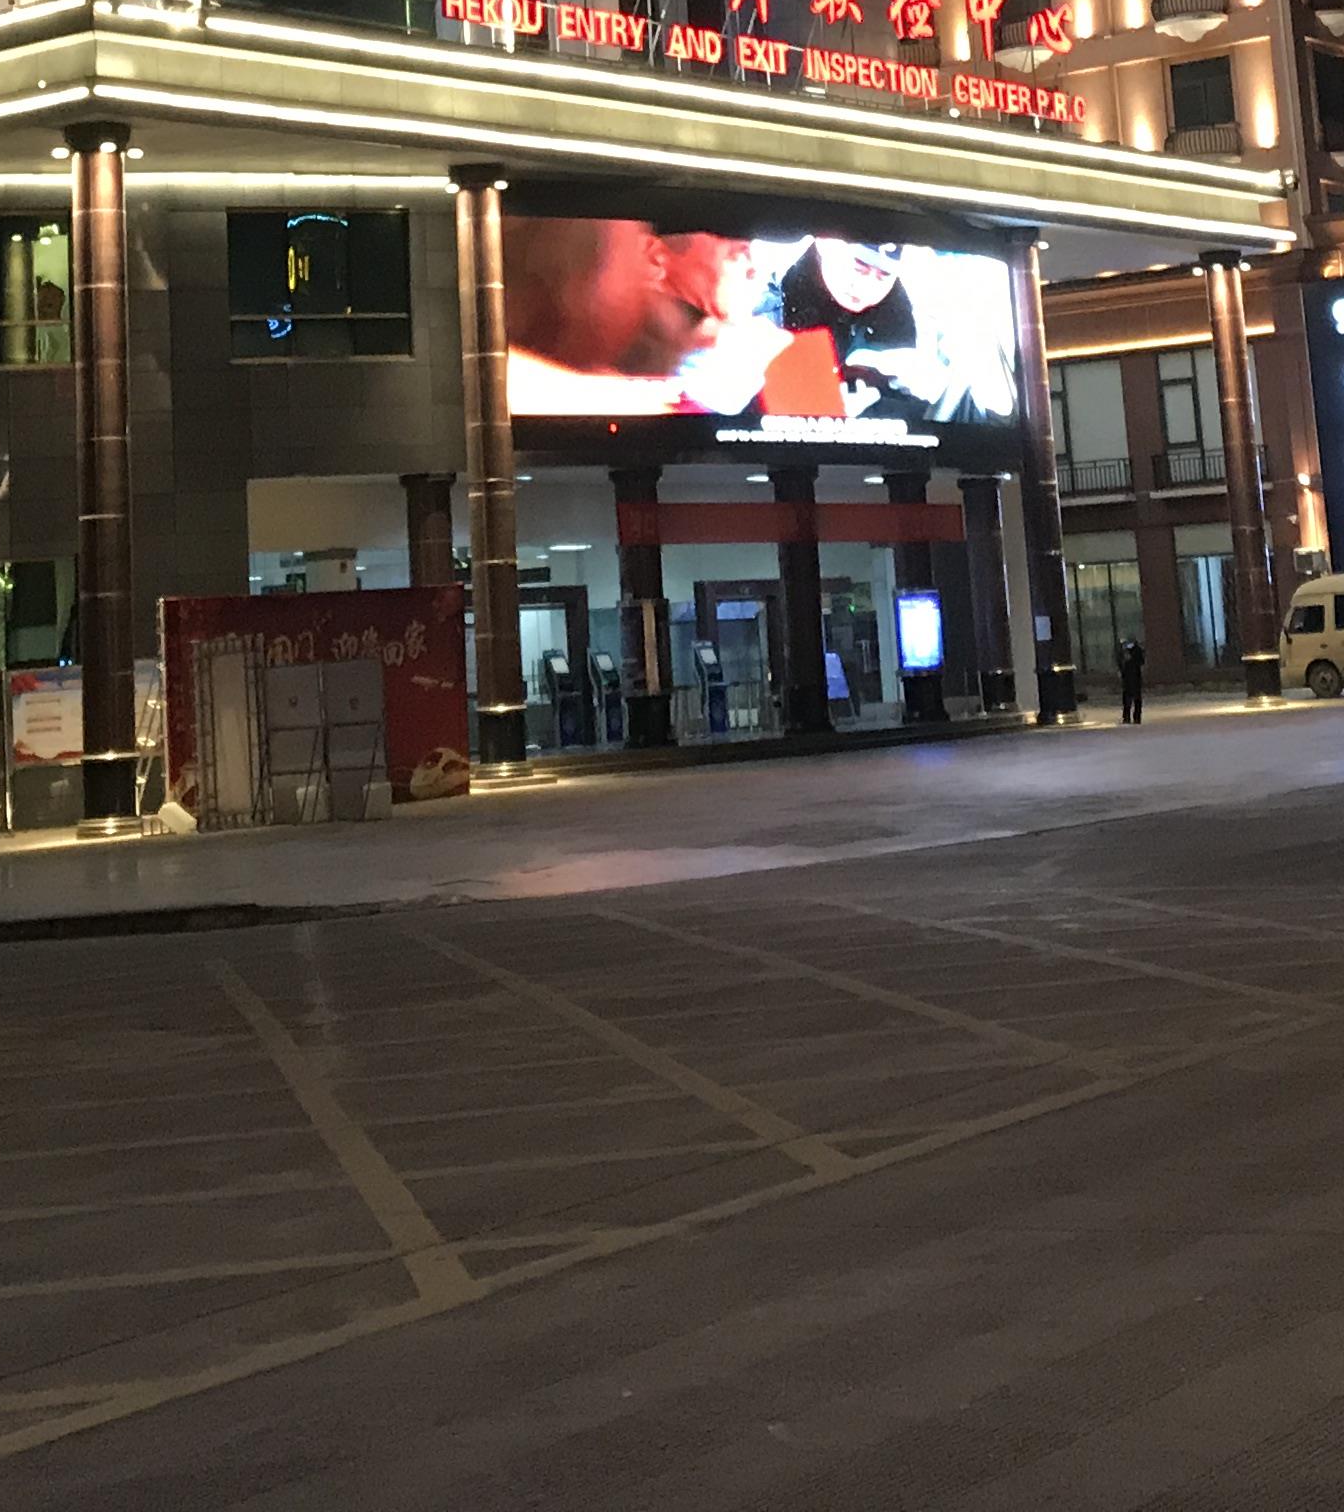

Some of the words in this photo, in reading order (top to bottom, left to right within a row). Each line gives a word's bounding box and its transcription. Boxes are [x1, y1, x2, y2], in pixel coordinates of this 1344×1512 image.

[556, 3, 646, 52] ENTRY
[664, 23, 723, 65] AND
[737, 34, 789, 76] EXIT
[803, 48, 940, 101] INSPECTION
